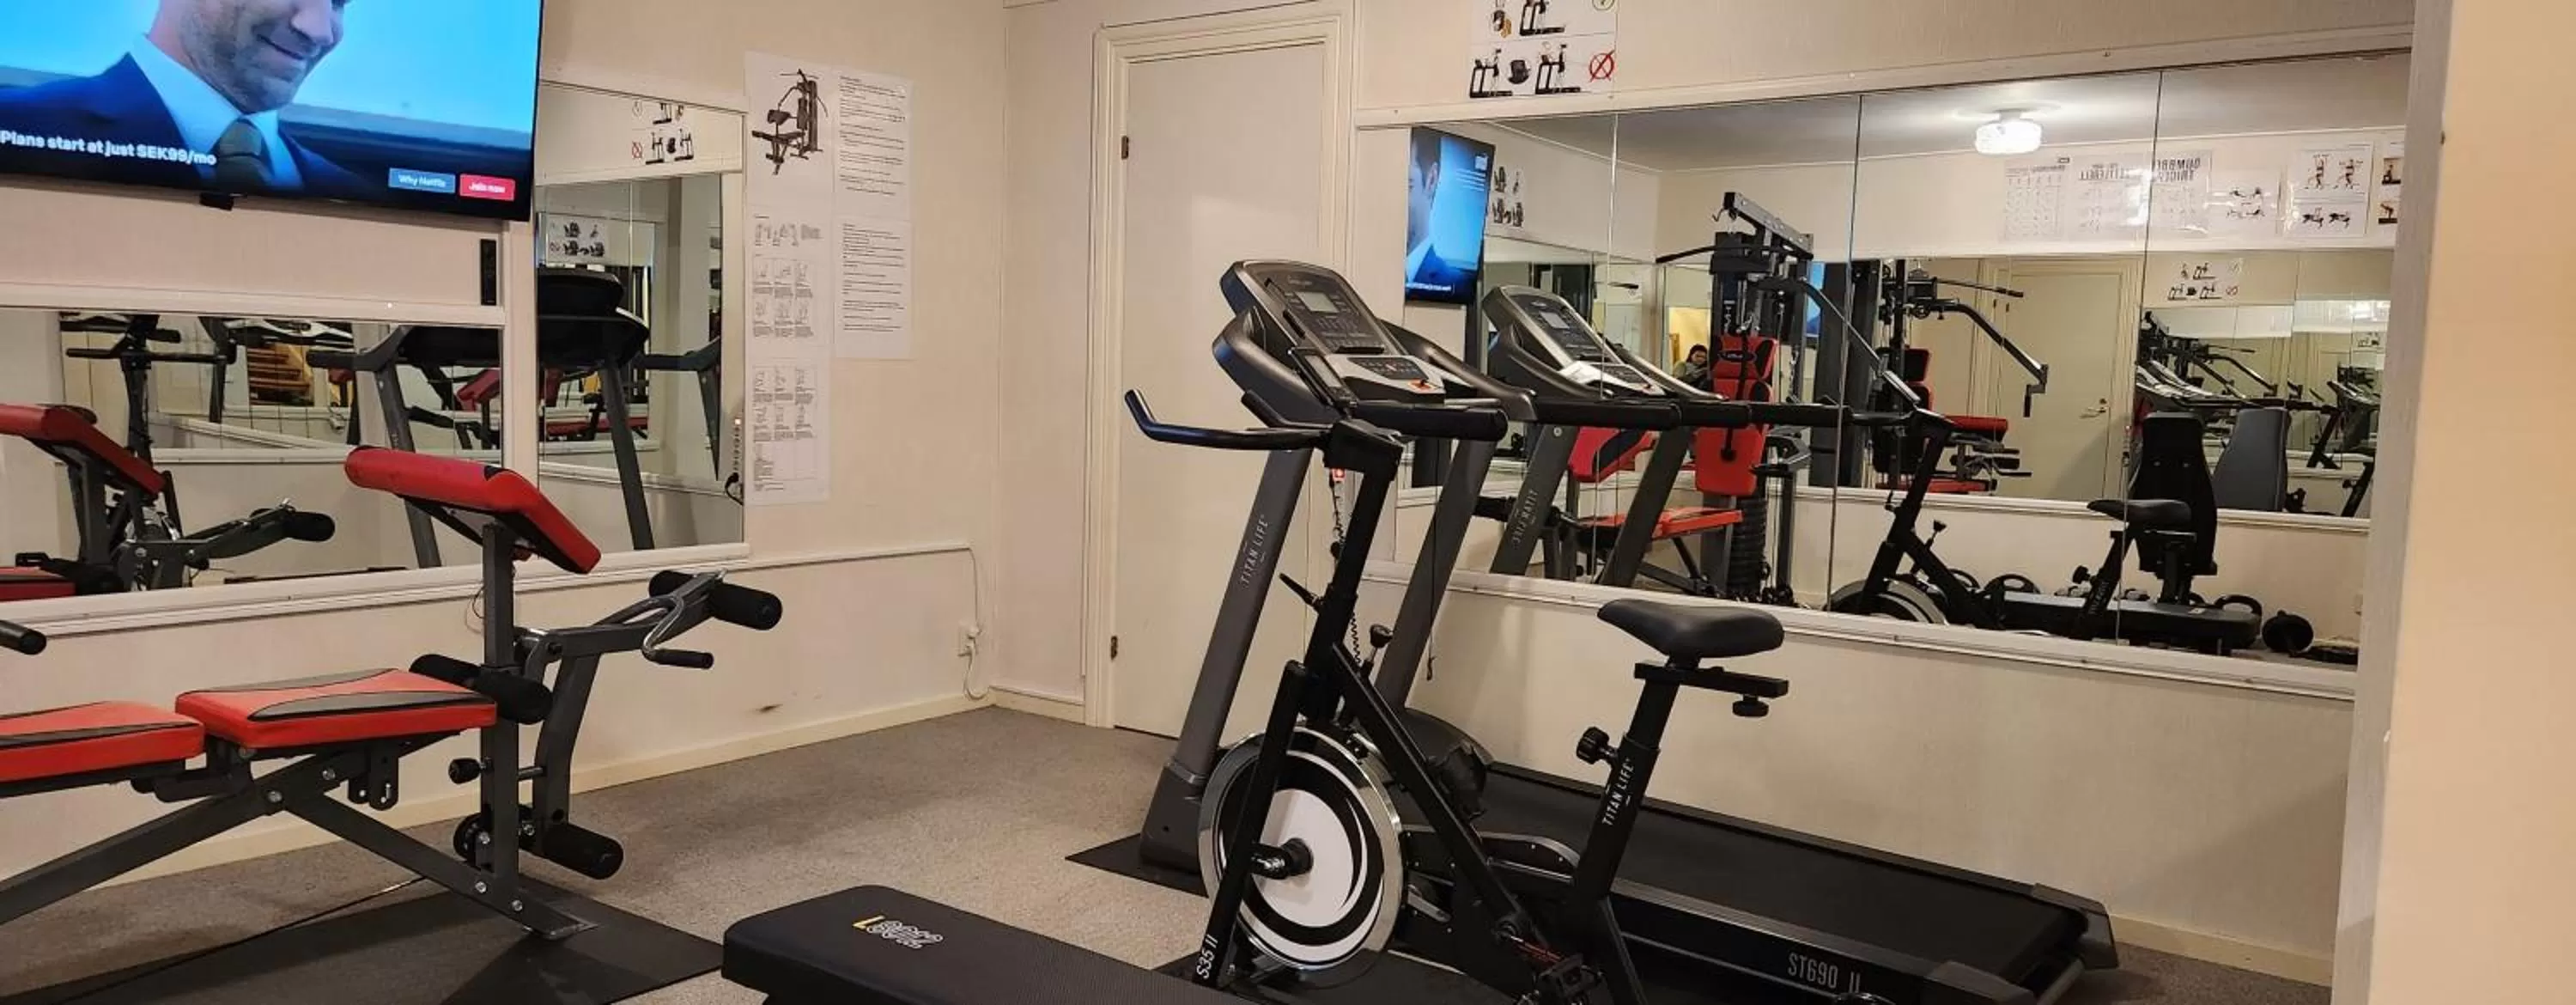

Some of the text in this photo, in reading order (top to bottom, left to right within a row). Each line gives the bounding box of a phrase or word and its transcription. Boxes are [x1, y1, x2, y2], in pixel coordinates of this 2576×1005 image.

[0, 130, 216, 166] Plans start at just SEK99/mo
[1240, 517, 1268, 584] TITAN LIFE
[1601, 762, 1634, 825] TITAN LIFE
[1196, 947, 1215, 979] S35
[1788, 952, 1838, 990] ST690
